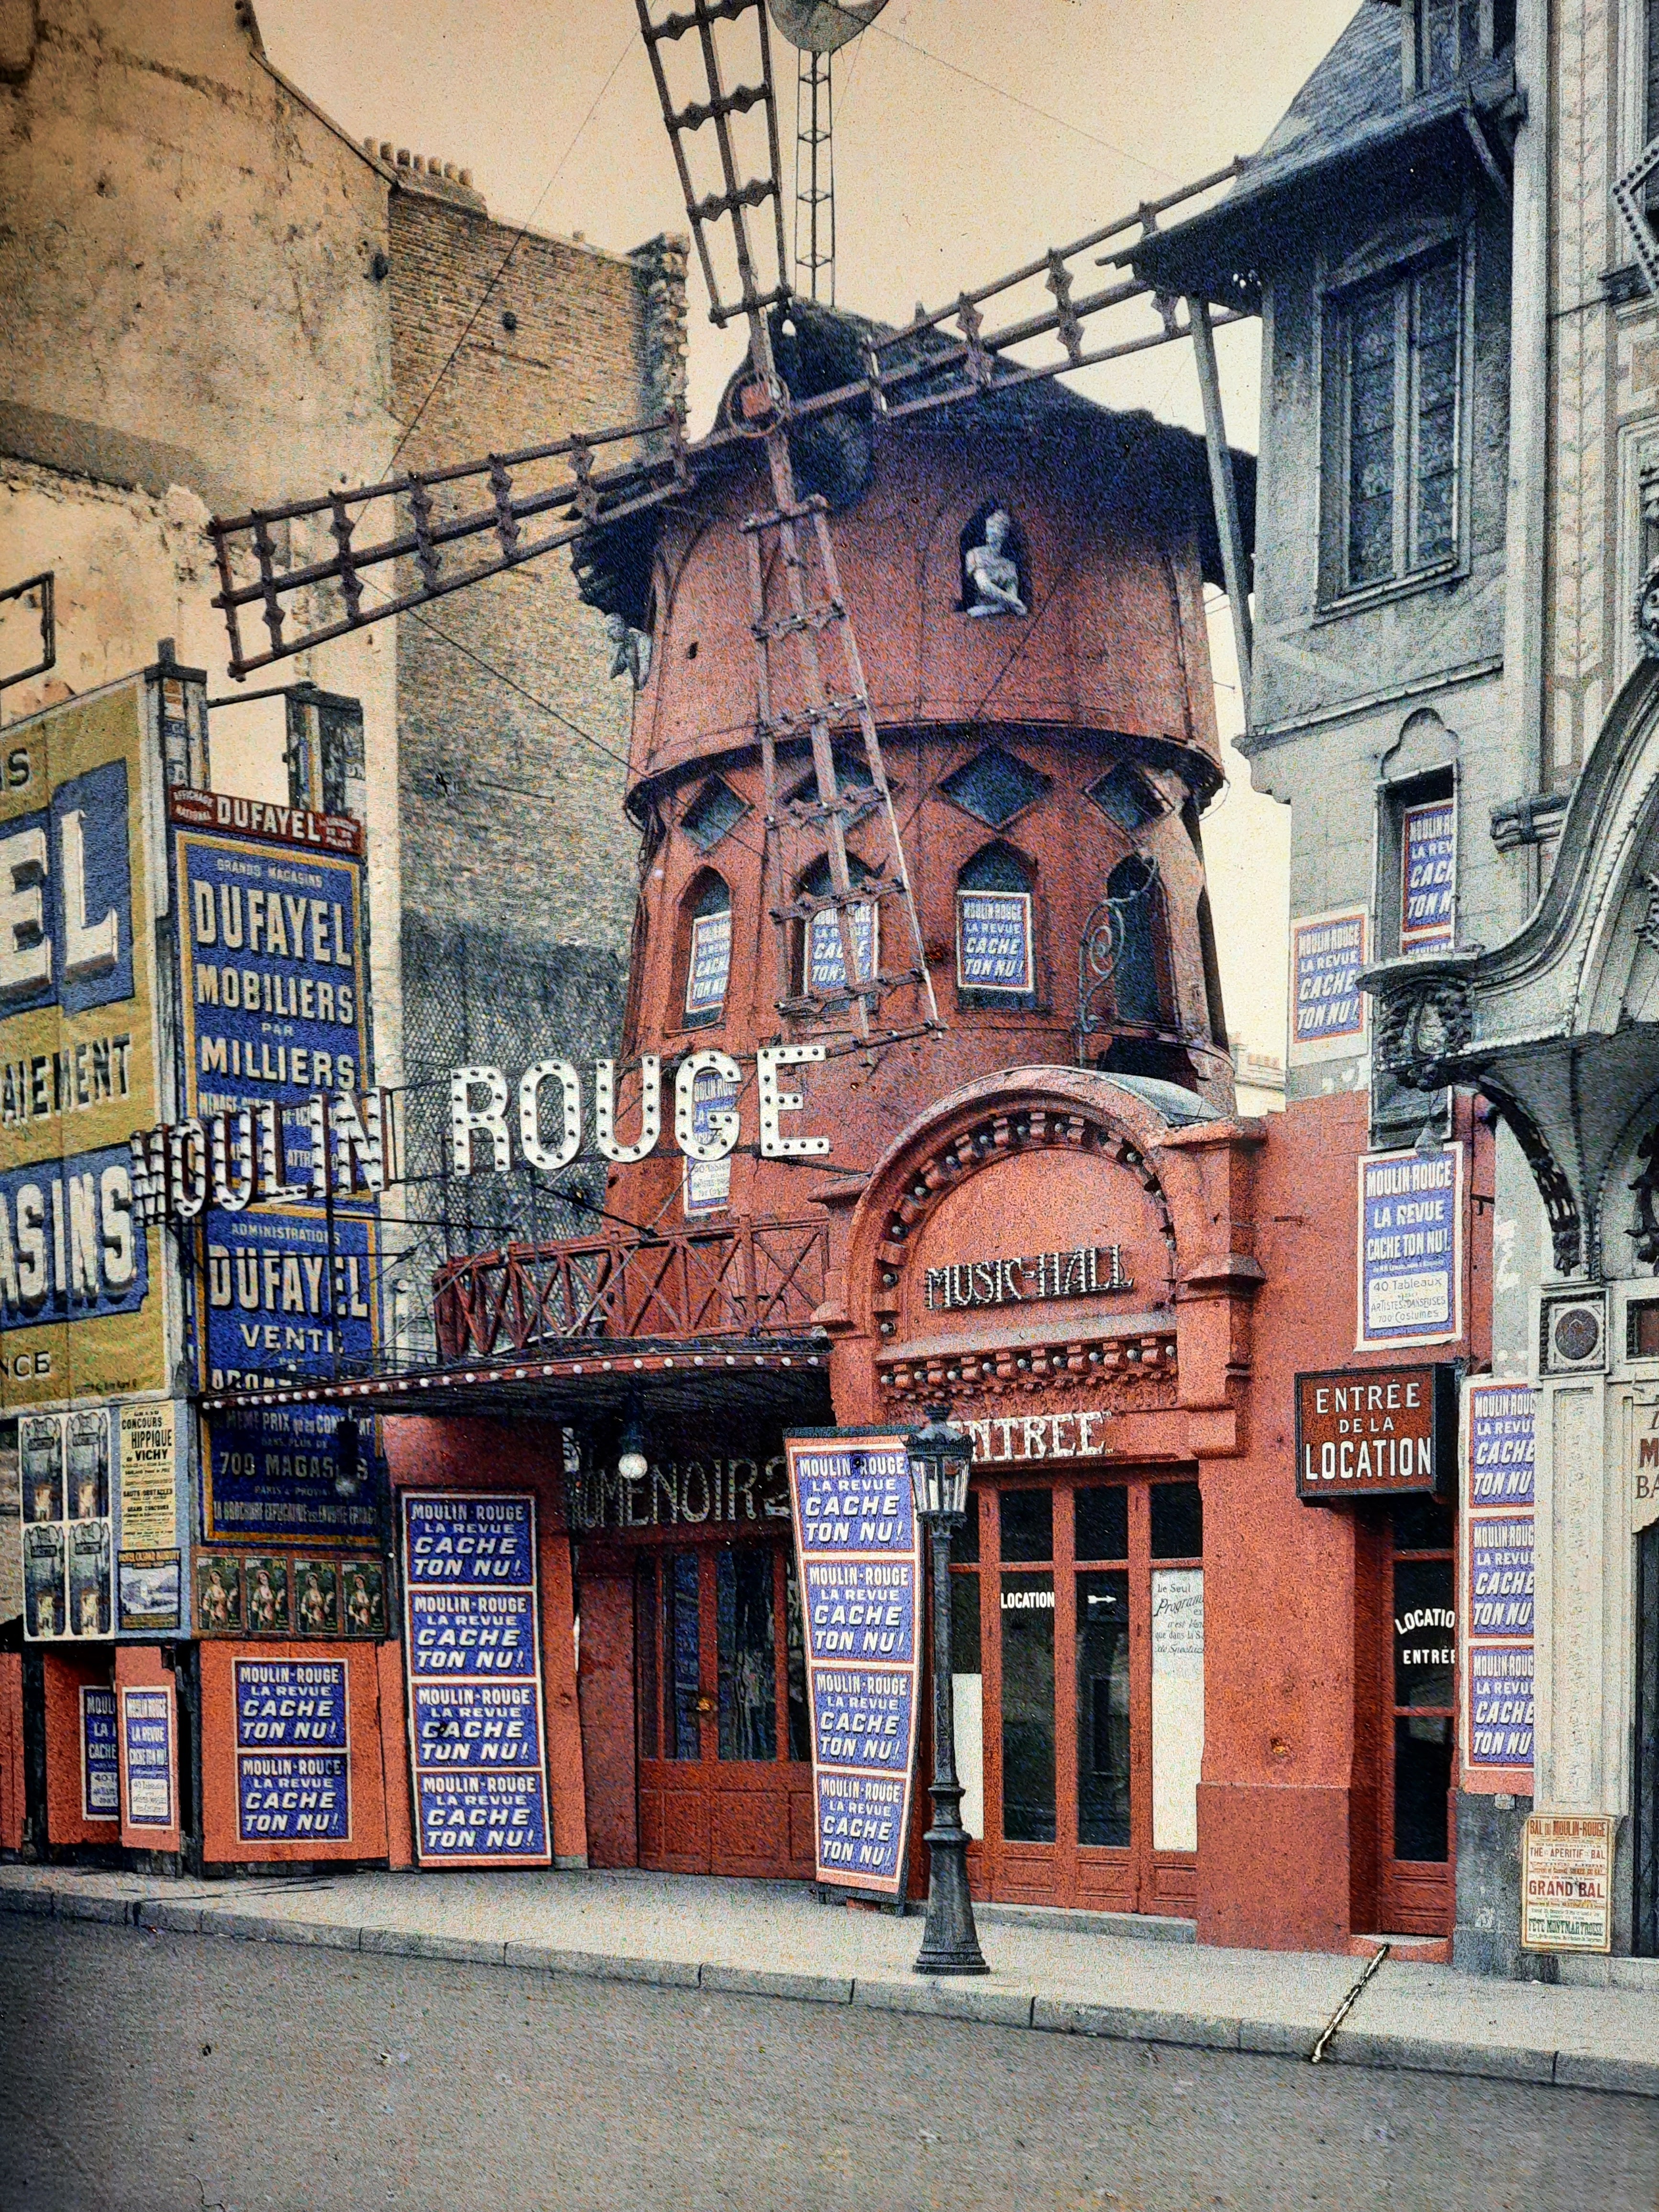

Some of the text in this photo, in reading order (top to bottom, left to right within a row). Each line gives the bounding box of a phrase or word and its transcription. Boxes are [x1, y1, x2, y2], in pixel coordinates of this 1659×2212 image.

[216, 796, 322, 842] DUFAYEL
[1412, 845, 1425, 859] LA
[217, 858, 262, 877] GRANDS
[1408, 895, 1438, 919] TON
[194, 879, 353, 966] DUFAYEL
[966, 922, 1021, 933] LA REVUE
[966, 937, 1021, 955] CACHE
[965, 959, 992, 976] TON
[1301, 951, 1358, 973] LA REVUE
[197, 963, 354, 1025] MOBILIERS
[1300, 969, 1355, 1001] CACHE
[1297, 1006, 1325, 1031] TON
[262, 1023, 294, 1037] PAR
[201, 1035, 354, 1090] MILLIERS
[451, 1046, 830, 1176] ROUGE
[131, 1086, 388, 1226] MOULIN
[1374, 1200, 1445, 1228] LA REVUE
[1367, 1235, 1402, 1261] CACHE
[1402, 1231, 1424, 1258] TON
[209, 1244, 368, 1317] DUFAYEL
[924, 1244, 1134, 1310] MUSIC-HALL
[1373, 1278, 1442, 1292] 40 Tableaux
[1316, 1379, 1421, 1414] ENTRÉE
[122, 1416, 162, 1430] CONCOURS
[262, 1412, 290, 1432] PRIX
[1339, 1416, 1394, 1434] DE LA
[1477, 1423, 1491, 1436] LA
[131, 1429, 172, 1449] HIPPIQUE
[135, 1448, 168, 1461] VICHY
[1305, 1437, 1431, 1481] LOCATION
[220, 1451, 368, 1481] 700 MAGASS
[812, 1478, 896, 1492] LA REVUE
[1473, 1471, 1534, 1496] TON NU
[411, 1504, 524, 1521] MOULIN-ROUGE
[805, 1494, 900, 1517] CACHE
[424, 1523, 515, 1534] LA REVUE
[806, 1522, 904, 1542] TON NU!
[415, 1537, 519, 1555] CACHE
[414, 1559, 522, 1577] TON NU!
[1477, 1553, 1491, 1566] LA
[809, 1566, 909, 1586] MOULIN-ROUGE
[820, 1588, 900, 1601] LA REVUE
[1157, 1583, 1191, 1593] Le Seul
[414, 1596, 527, 1613] MOULIN-ROUGE
[1000, 1591, 1055, 1609] LOCATION
[1153, 1594, 1204, 1617] Program
[427, 1615, 518, 1626] LA REVUE
[814, 1604, 903, 1626] CACHE
[1394, 1608, 1455, 1635] LOCATIO
[1473, 1603, 1534, 1626] TON NU
[417, 1628, 520, 1647] CACHE
[814, 1630, 905, 1652] TON NU!
[1155, 1632, 1166, 1641] que
[417, 1650, 525, 1669] TON NU!
[240, 1667, 339, 1684] MOULIN-ROUGE
[251, 1686, 332, 1697] LA REVUE
[817, 1674, 907, 1696] MOULIN-ROUGE
[1476, 1681, 1491, 1695] LA
[419, 1688, 531, 1705] MOULIN-ROUGE
[827, 1696, 899, 1711] LA REVUE
[243, 1700, 334, 1717] CACHE
[431, 1707, 521, 1718] LA REVUE
[94, 1723, 109, 1737] LA
[243, 1722, 337, 1739] TON NU!
[422, 1721, 525, 1738] CACHE
[820, 1712, 900, 1735] CACHE
[88, 1744, 117, 1759] CACHE
[481, 1742, 530, 1760] NU!
[820, 1736, 900, 1760] TON NU!
[1473, 1732, 1534, 1755] TON NU
[243, 1759, 342, 1776] MOULIN-ROUGE
[254, 1778, 334, 1789] LA REVUE
[423, 1776, 536, 1793] MOULIN-ROUGE
[821, 1778, 900, 1803] MOULIN-ROUGE
[245, 1792, 336, 1809] CACHE
[435, 1795, 527, 1806] LA REVUE
[830, 1800, 891, 1817] LA REVUE
[245, 1813, 339, 1832] TON NU!
[427, 1808, 531, 1826] CACHE
[823, 1815, 893, 1842] CACHE
[1530, 1820, 1606, 1837] BAL MOULIN-ROUGE
[427, 1830, 535, 1848] TON NU!
[822, 1839, 892, 1867] TON NU!
[1591, 1849, 1606, 1859] BAL
[1529, 1880, 1605, 1899] GRAND BAL
